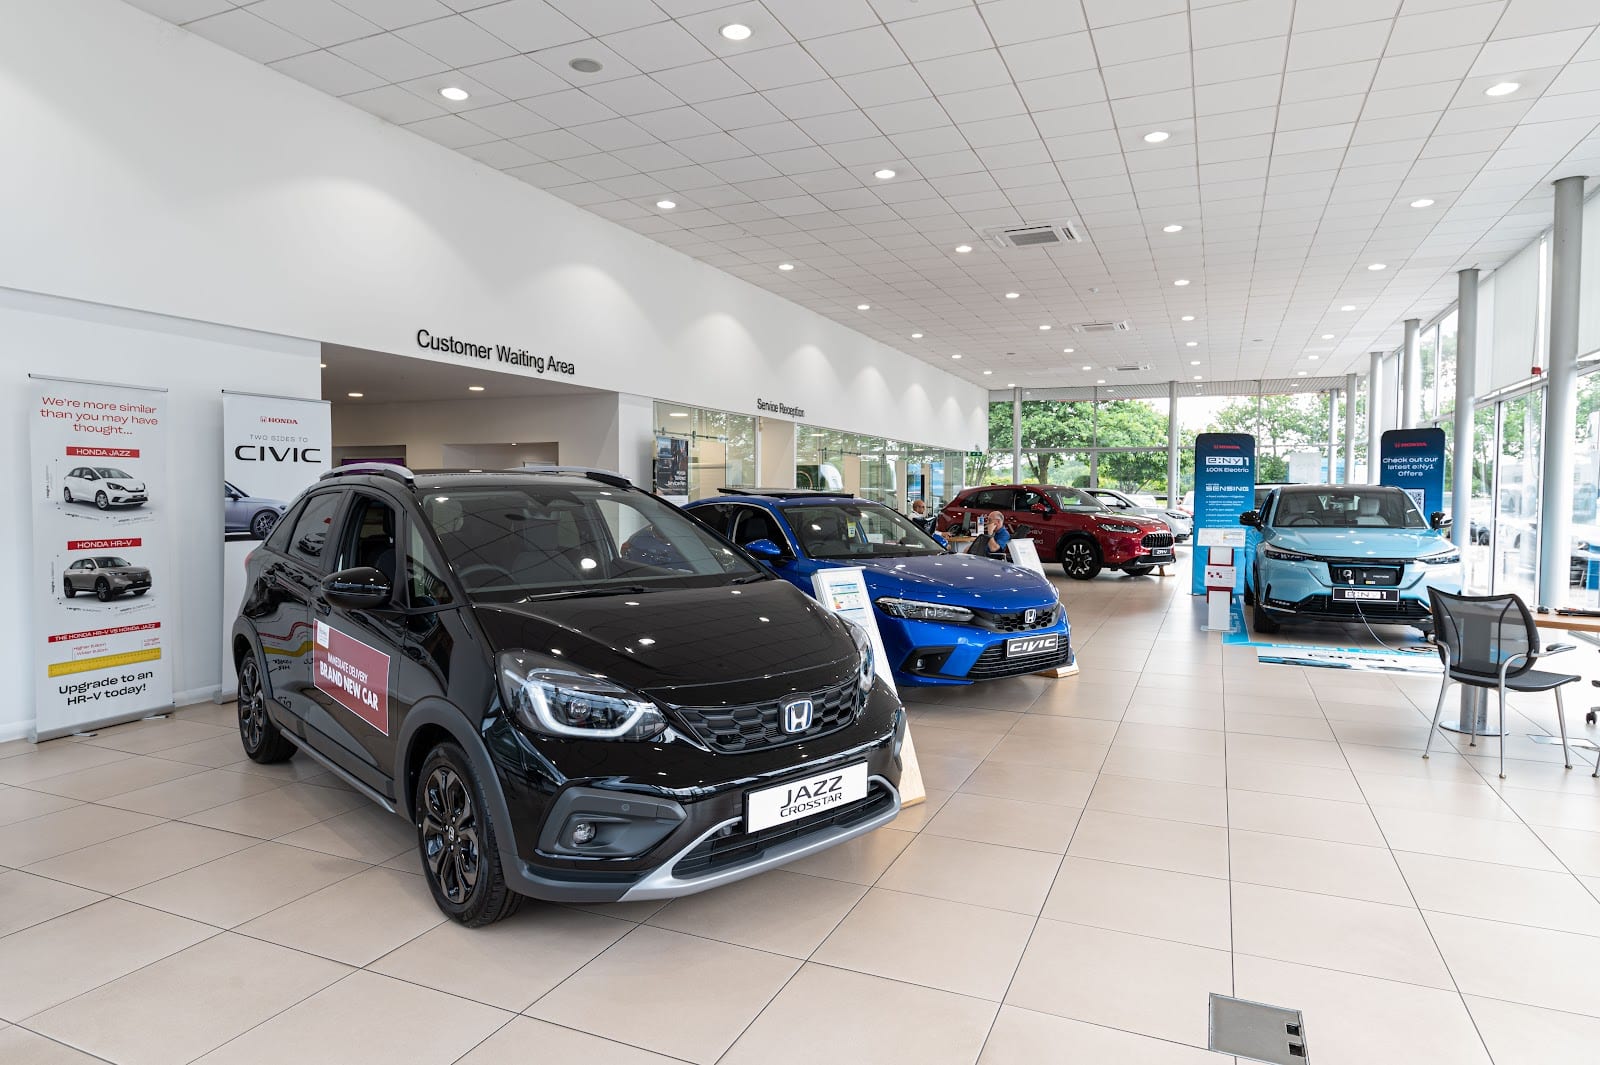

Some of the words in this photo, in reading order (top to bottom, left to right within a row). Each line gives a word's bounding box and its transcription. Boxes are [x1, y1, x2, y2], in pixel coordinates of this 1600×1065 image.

[416, 328, 493, 360] Customer
[495, 344, 545, 374] Waiting
[547, 355, 575, 375] Area
[41, 396, 80, 408] We're
[83, 401, 117, 410] more
[119, 403, 157, 414] similar
[757, 398, 779, 413] Service
[779, 402, 805, 418] Reception
[40, 408, 73, 419] than
[75, 412, 99, 421] you
[102, 414, 129, 425] may
[131, 415, 158, 425] have
[267, 417, 298, 425] HONDA
[73, 423, 133, 435] thought...
[76, 448, 108, 456] HONDA
[109, 449, 131, 457] JAZZ
[234, 445, 322, 464] CIVIC
[1382, 456, 1408, 464] Check
[77, 540, 109, 549] HONDA
[110, 539, 133, 547] HR-V
[68, 631, 93, 639] HONDA
[1009, 638, 1057, 652] CIVIC
[327, 652, 349, 673] IMMEDIATE
[348, 664, 369, 684] DELIVERY
[58, 676, 119, 695] Upgrade
[121, 672, 135, 683] to
[137, 671, 154, 680] an
[319, 660, 343, 688] BRAND
[343, 675, 361, 700] NEW
[361, 687, 379, 712] CAR
[67, 691, 102, 706] HR-V
[104, 683, 147, 698] today!
[780, 775, 843, 810] JAZZ
[780, 792, 842, 818] CROSSTAR
